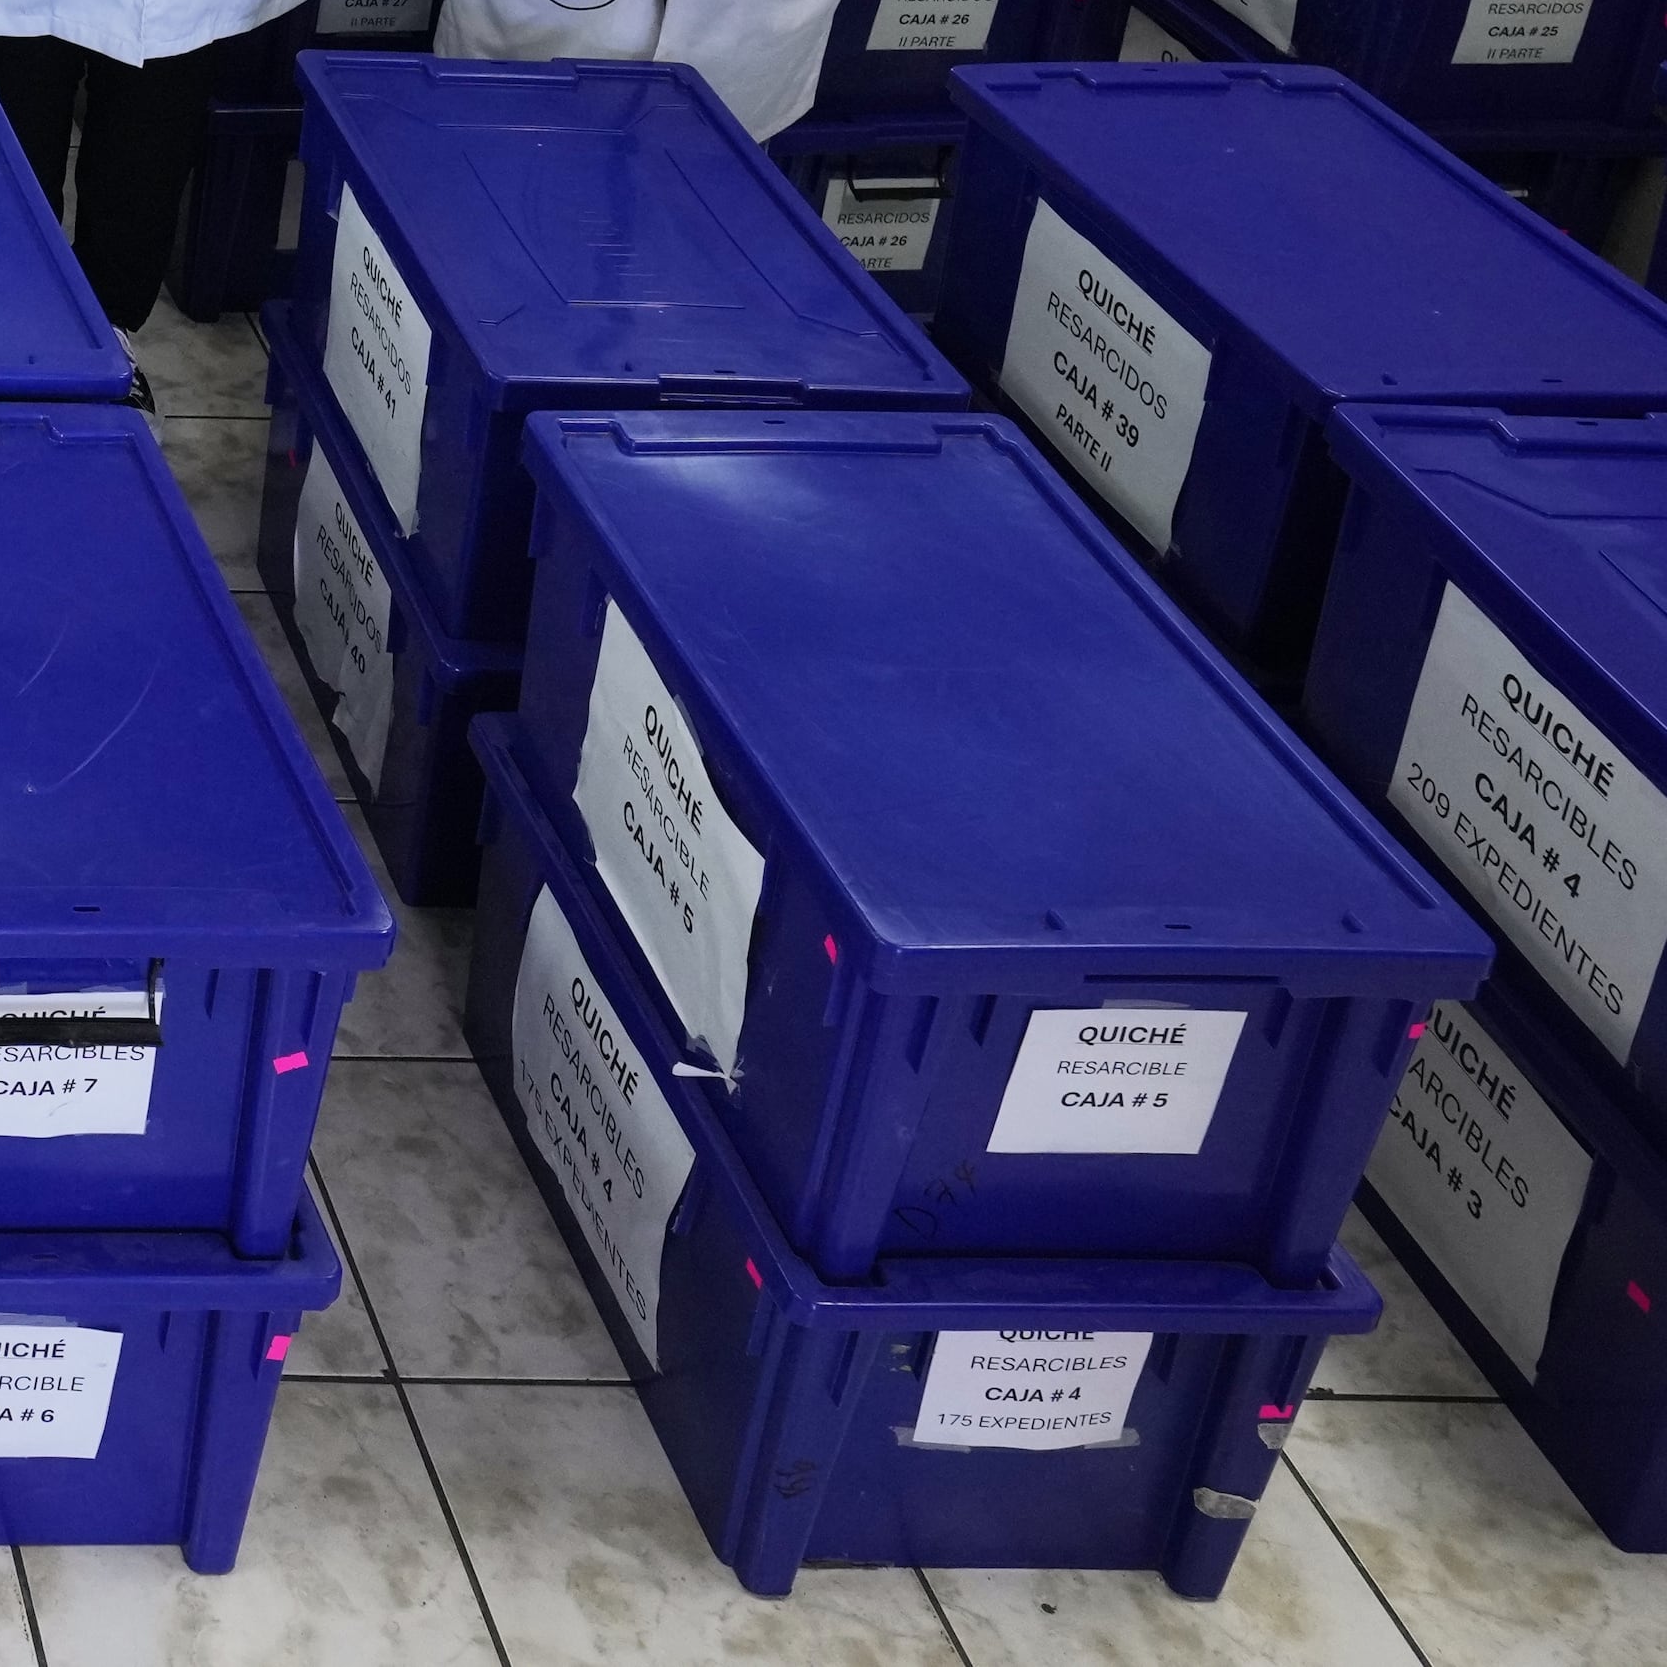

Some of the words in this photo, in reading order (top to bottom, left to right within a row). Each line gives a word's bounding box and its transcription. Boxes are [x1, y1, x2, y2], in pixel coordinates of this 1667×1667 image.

[899, 14, 936, 25] CAJA
[940, 14, 948, 24] #
[952, 14, 969, 24] 26
[899, 37, 907, 47] II
[909, 36, 956, 47] PARTE
[1488, 3, 1584, 15] RESARCIDOS
[1488, 26, 1526, 37] CAJA
[1529, 26, 1539, 36] #
[1541, 26, 1559, 37] 25
[1487, 48, 1495, 59] II
[1499, 47, 1544, 59] PARTE
[363, 246, 403, 328] QUICHÉ
[1078, 269, 1156, 353] QUICHÉ
[350, 272, 411, 395] RESARCIDOS
[351, 327, 376, 383] CAJA
[377, 374, 385, 394] #
[385, 390, 396, 419] 41
[1047, 291, 1168, 421] RESARCIDOS
[1053, 350, 1098, 410] CAJA
[1101, 399, 1114, 421] #
[1116, 414, 1139, 448] 39
[1056, 403, 1101, 461] PARTE
[1100, 451, 1112, 472] II
[644, 705, 703, 836] QUICHÉ
[1502, 673, 1614, 795] QUICHÉ
[623, 734, 710, 902] RESARCIBLE
[1461, 693, 1637, 891] RESARCIBLES
[623, 800, 666, 888] CAJA
[670, 881, 680, 907] #
[682, 902, 694, 935] 5
[1474, 773, 1537, 854] CAJA
[1542, 847, 1560, 872] #
[1564, 874, 1581, 898] 4
[1408, 762, 1451, 818] 209
[1453, 811, 1623, 1016] EXPEDIENTES
[571, 977, 639, 1106] QUICHÉ
[1056, 1060, 1188, 1076] RESARCIBLE
[1078, 1023, 1186, 1046] QUICHÉ
[62, 1079, 76, 1094] #
[85, 1078, 98, 1094] 7
[543, 993, 645, 1200] RESARCIBLES
[1060, 1091, 1125, 1107] CAJA
[1132, 1093, 1147, 1107] #
[1152, 1092, 1168, 1107] 5
[550, 1071, 589, 1159] CAJA
[591, 1151, 600, 1175] #
[604, 1178, 613, 1203] 4
[970, 1355, 1127, 1373] RESARCIBLES
[985, 1387, 1044, 1402] CAJA
[1051, 1387, 1065, 1401] #
[1068, 1386, 1082, 1401] 4
[20, 1408, 35, 1422] #
[41, 1408, 55, 1423] 6
[938, 1413, 972, 1428] 175
[979, 1412, 1112, 1431] EXPEDIENTES
